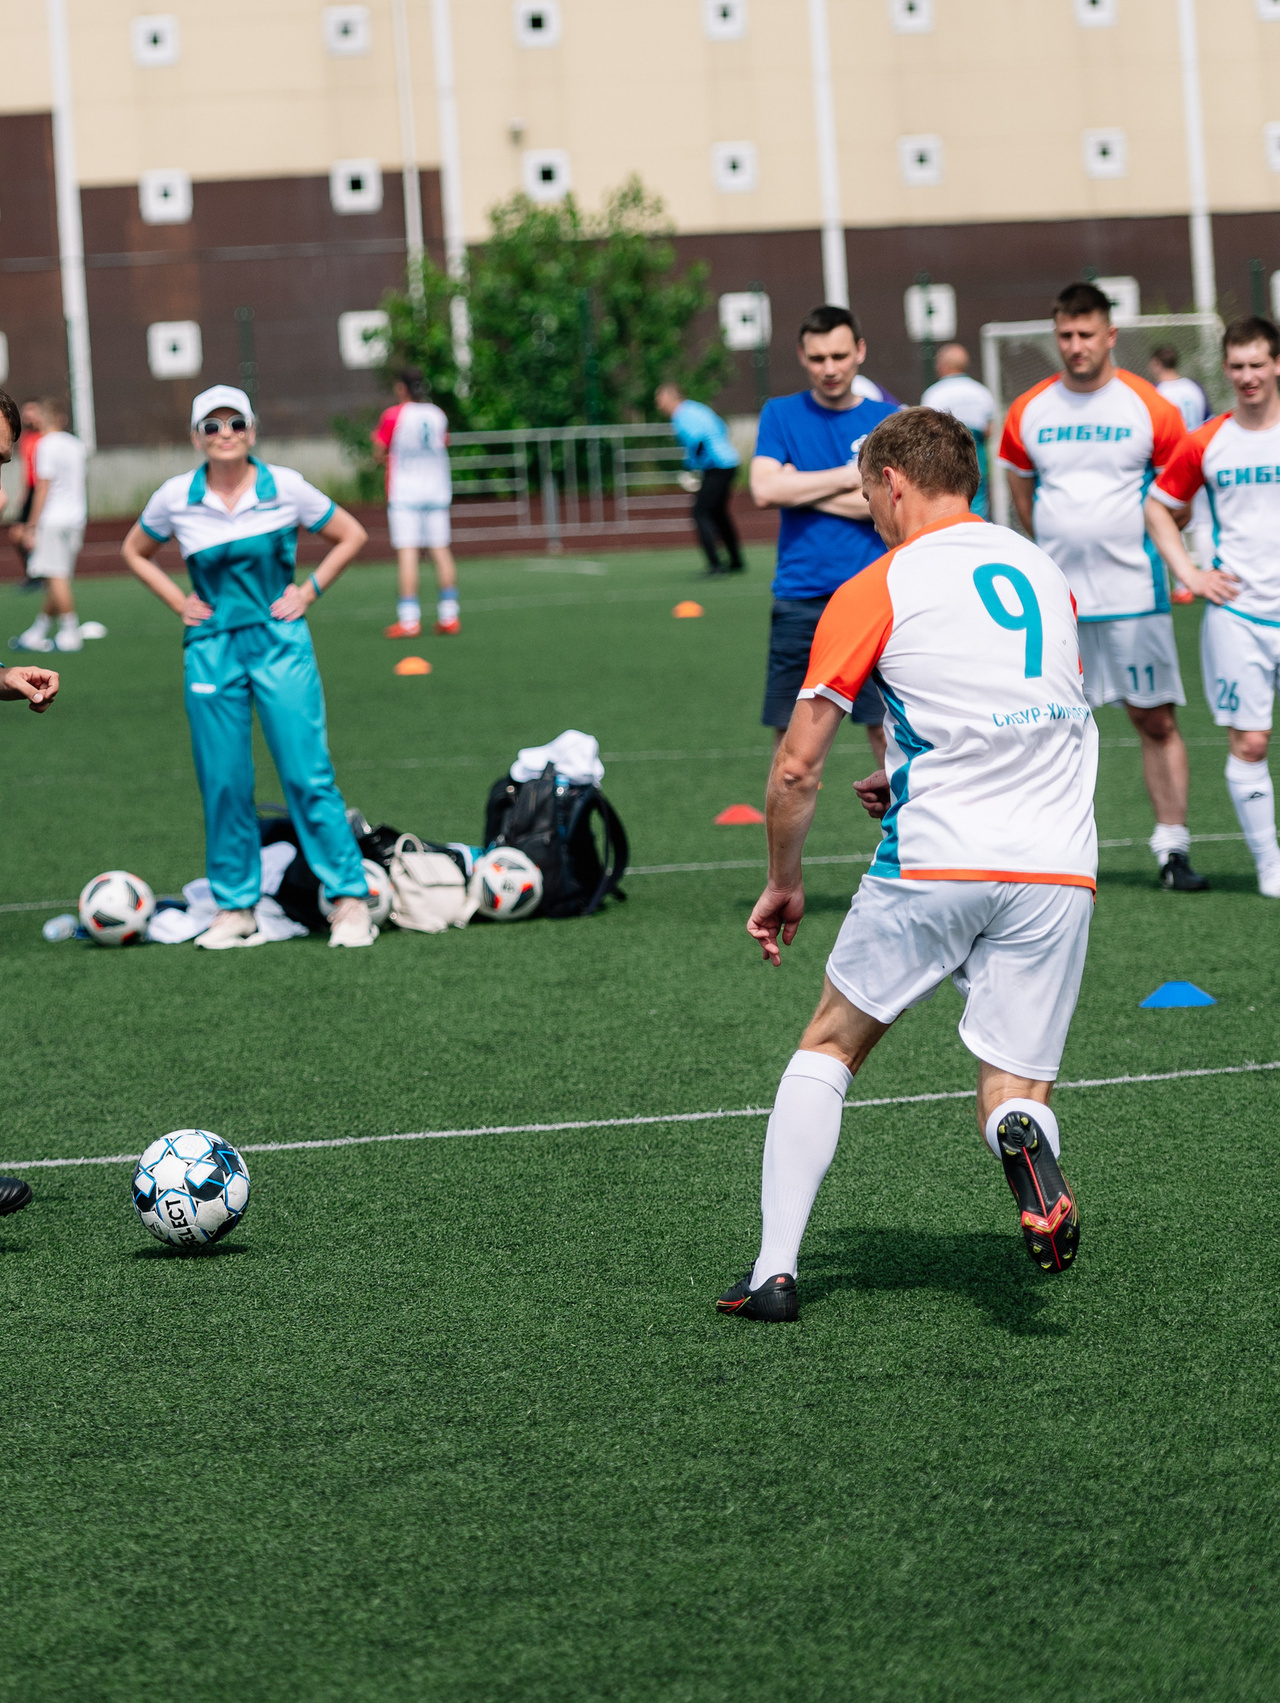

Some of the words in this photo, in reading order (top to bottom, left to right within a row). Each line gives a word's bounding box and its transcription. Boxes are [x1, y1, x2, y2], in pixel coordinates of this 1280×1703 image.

[1038, 425, 1131, 444] СИБУР
[1217, 465, 1280, 488] СИБ
[973, 562, 1043, 679] 9
[1128, 665, 1154, 691] 11
[1217, 679, 1239, 712] 26
